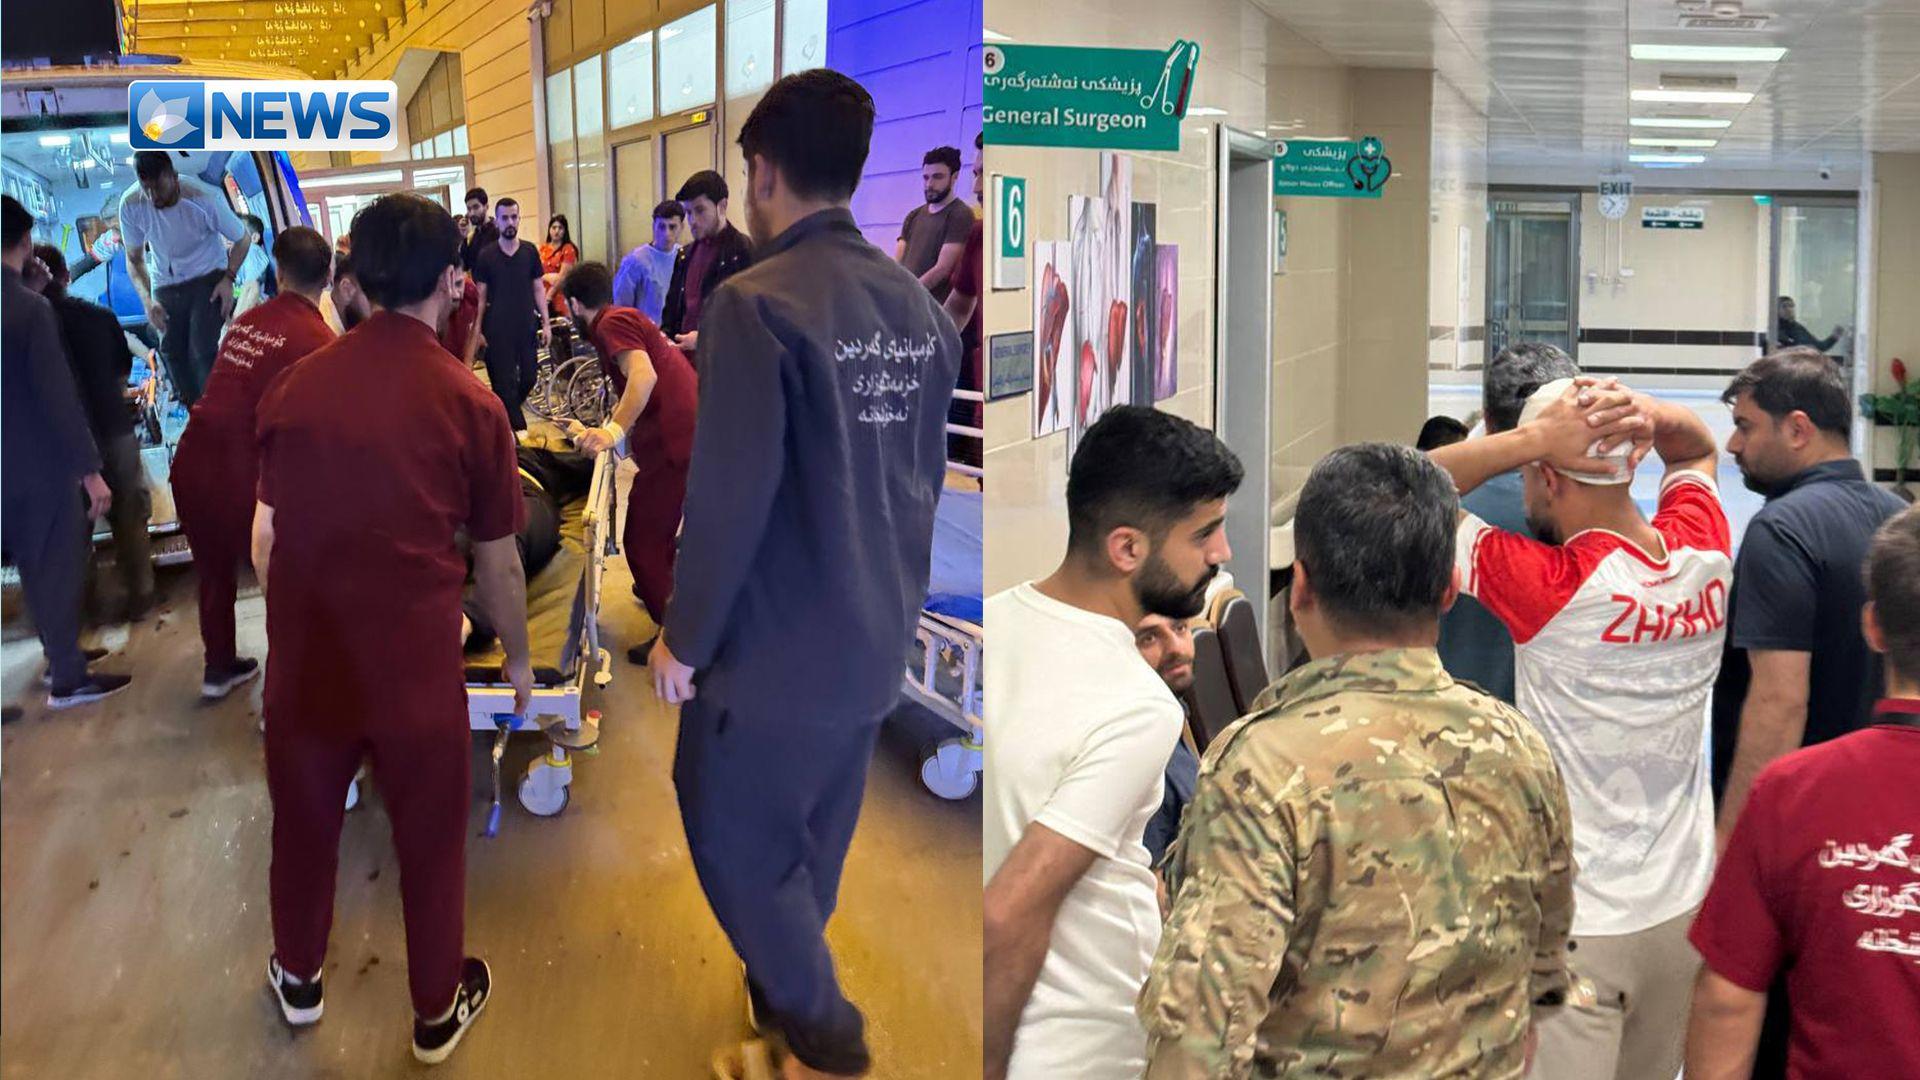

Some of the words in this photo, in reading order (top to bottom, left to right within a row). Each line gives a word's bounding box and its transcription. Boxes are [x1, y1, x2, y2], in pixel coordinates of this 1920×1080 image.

[984, 53, 995, 68] 6
[983, 71, 1078, 91] نەشتەرگەری
[1082, 74, 1142, 96] پزیشکی
[983, 106, 1058, 126] General
[1064, 108, 1146, 132] Surgeon
[1600, 182, 1632, 195] EXIT
[1008, 184, 1022, 248] 6
